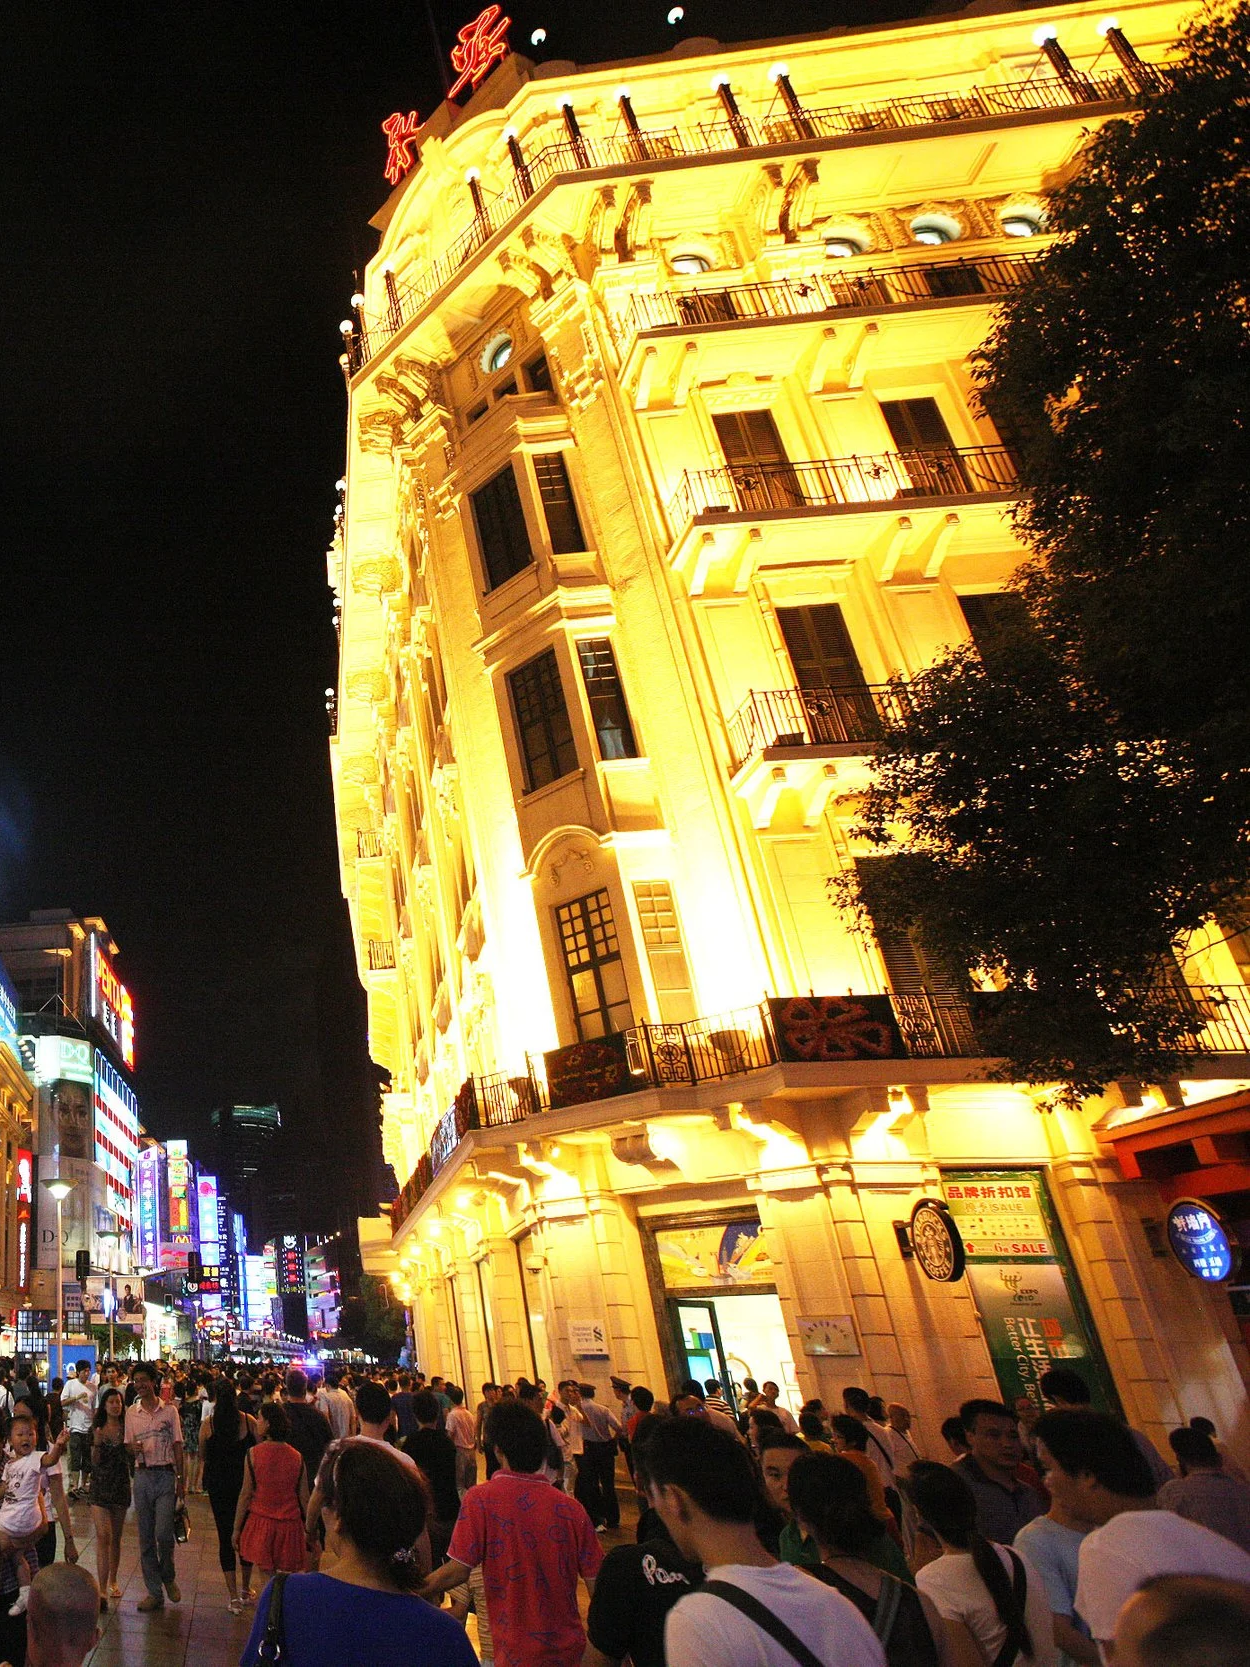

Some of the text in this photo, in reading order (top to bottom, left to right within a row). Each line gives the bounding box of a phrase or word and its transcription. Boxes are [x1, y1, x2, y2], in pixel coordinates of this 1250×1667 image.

[947, 1186, 1032, 1199] 品牌折扣馆
[991, 1203, 1025, 1212] SALE
[1011, 1243, 1048, 1254] SALE
[1003, 1317, 1023, 1353] Better
